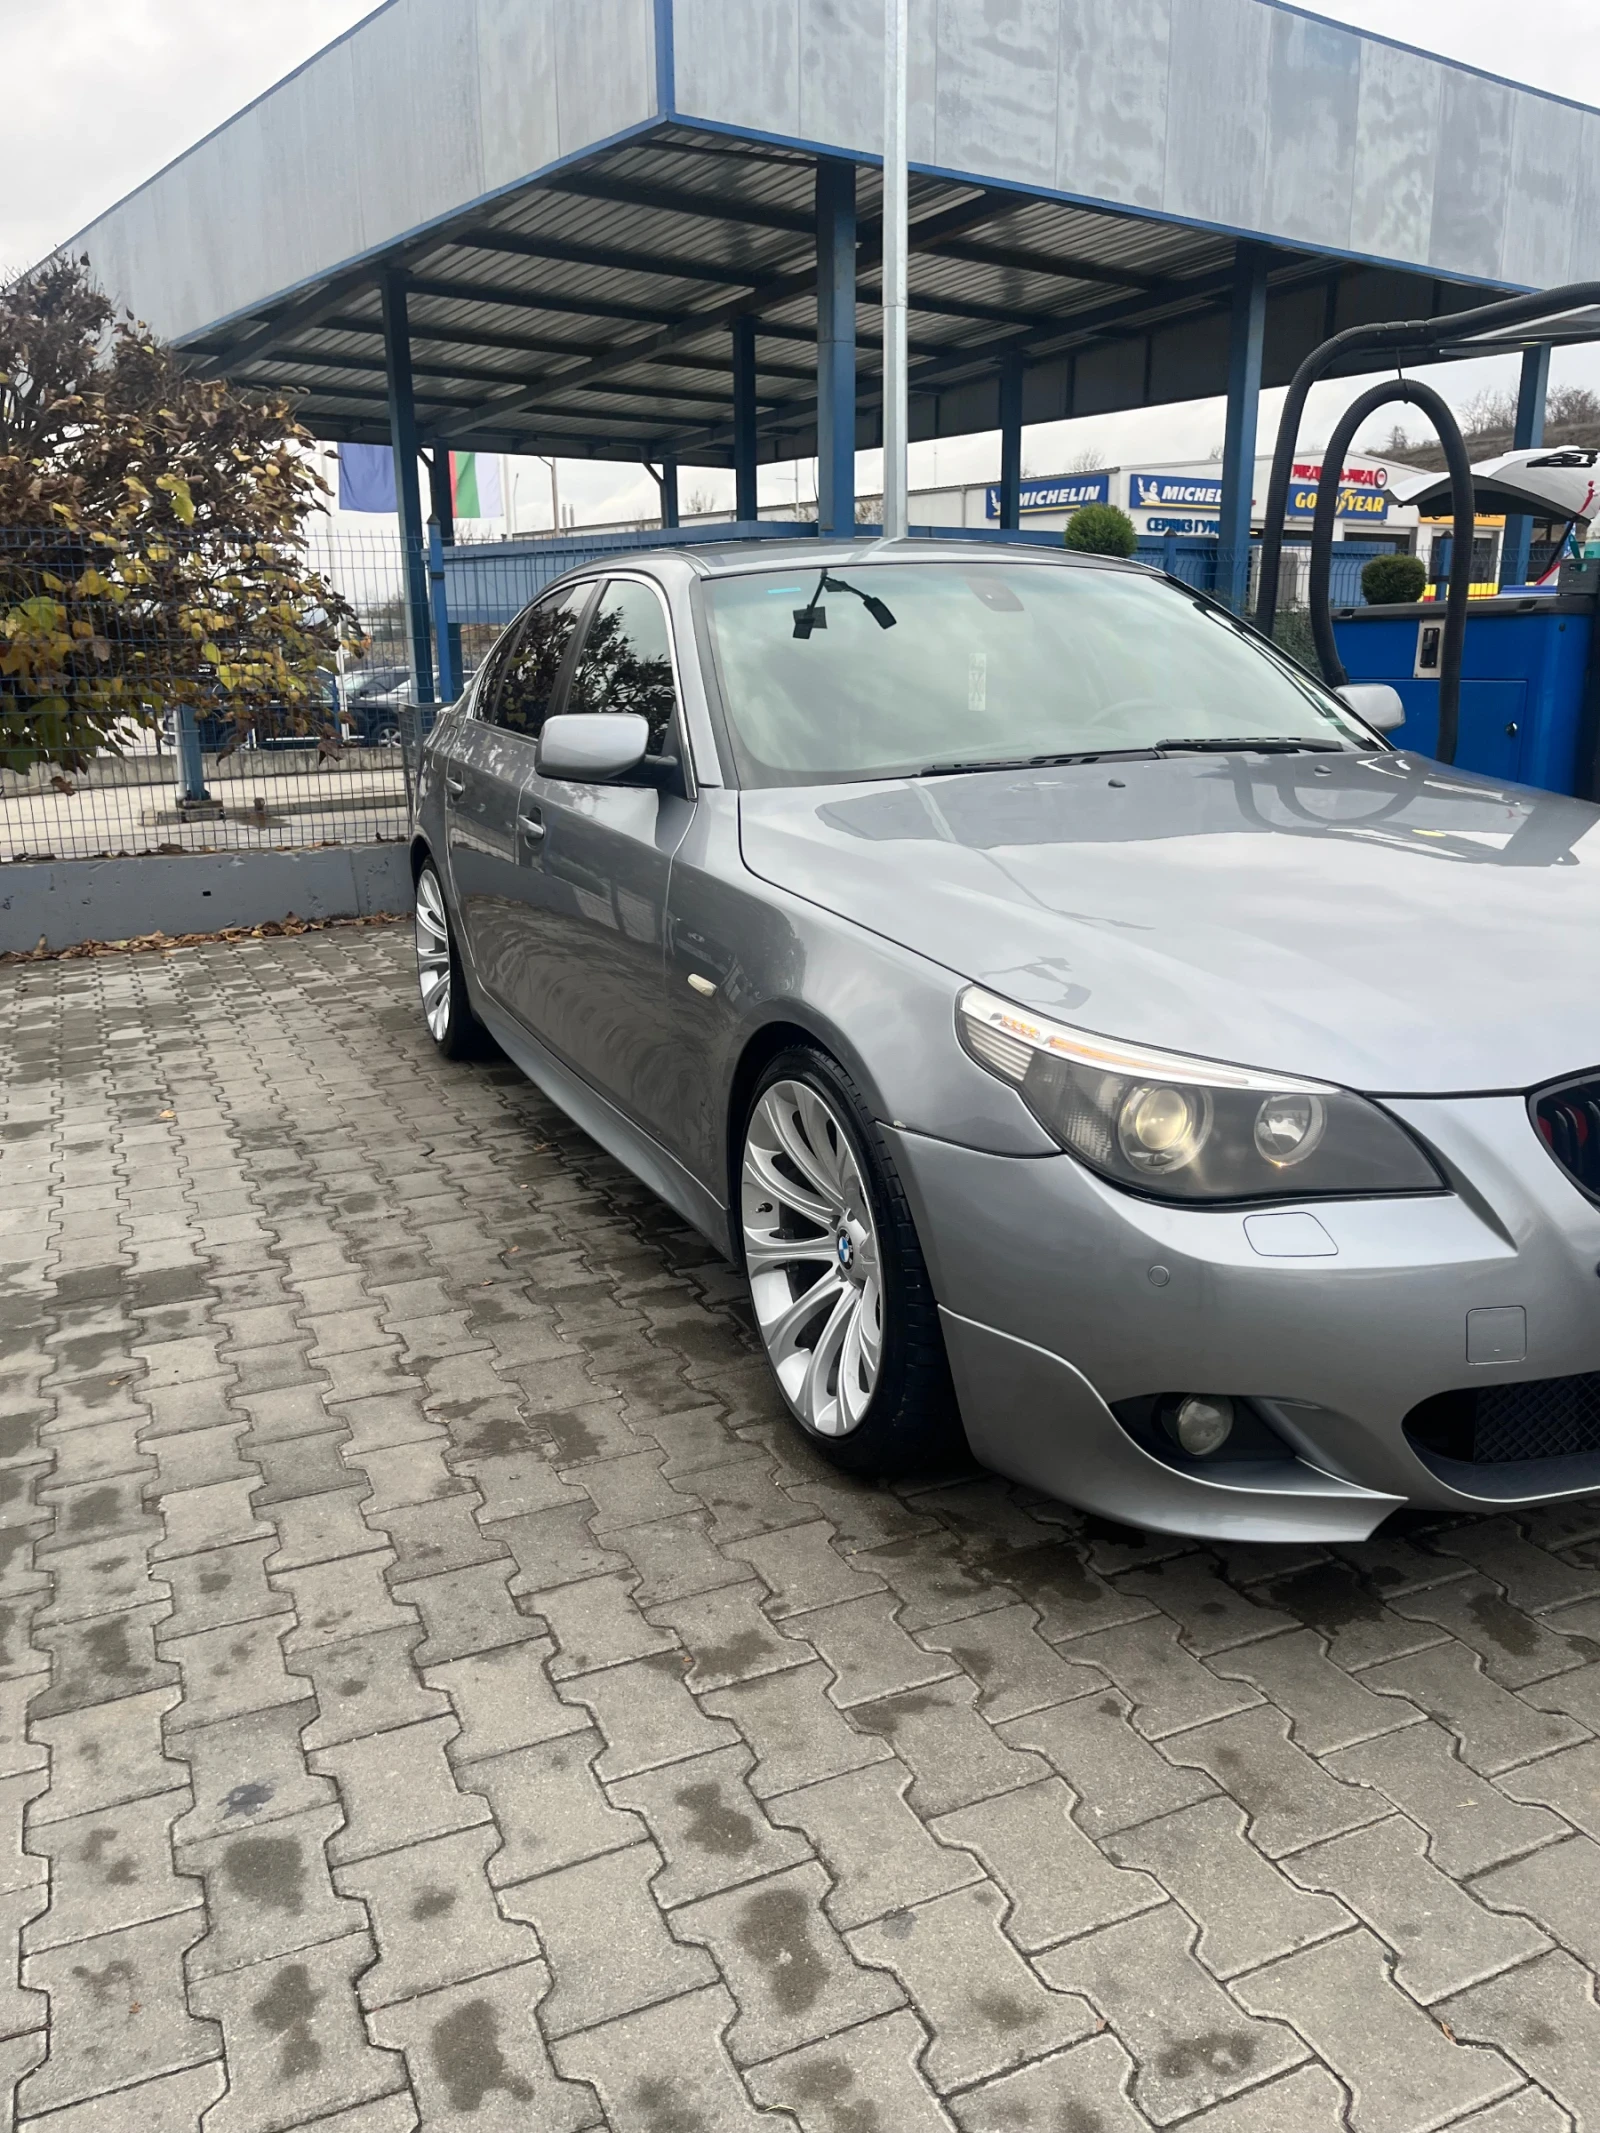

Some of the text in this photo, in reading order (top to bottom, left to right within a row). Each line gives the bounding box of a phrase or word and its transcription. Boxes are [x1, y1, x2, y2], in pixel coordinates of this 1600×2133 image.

[1019, 485, 1100, 507] MICHELIN
[1162, 485, 1222, 503] MICHEL
[1295, 492, 1385, 512] GOYEAR
